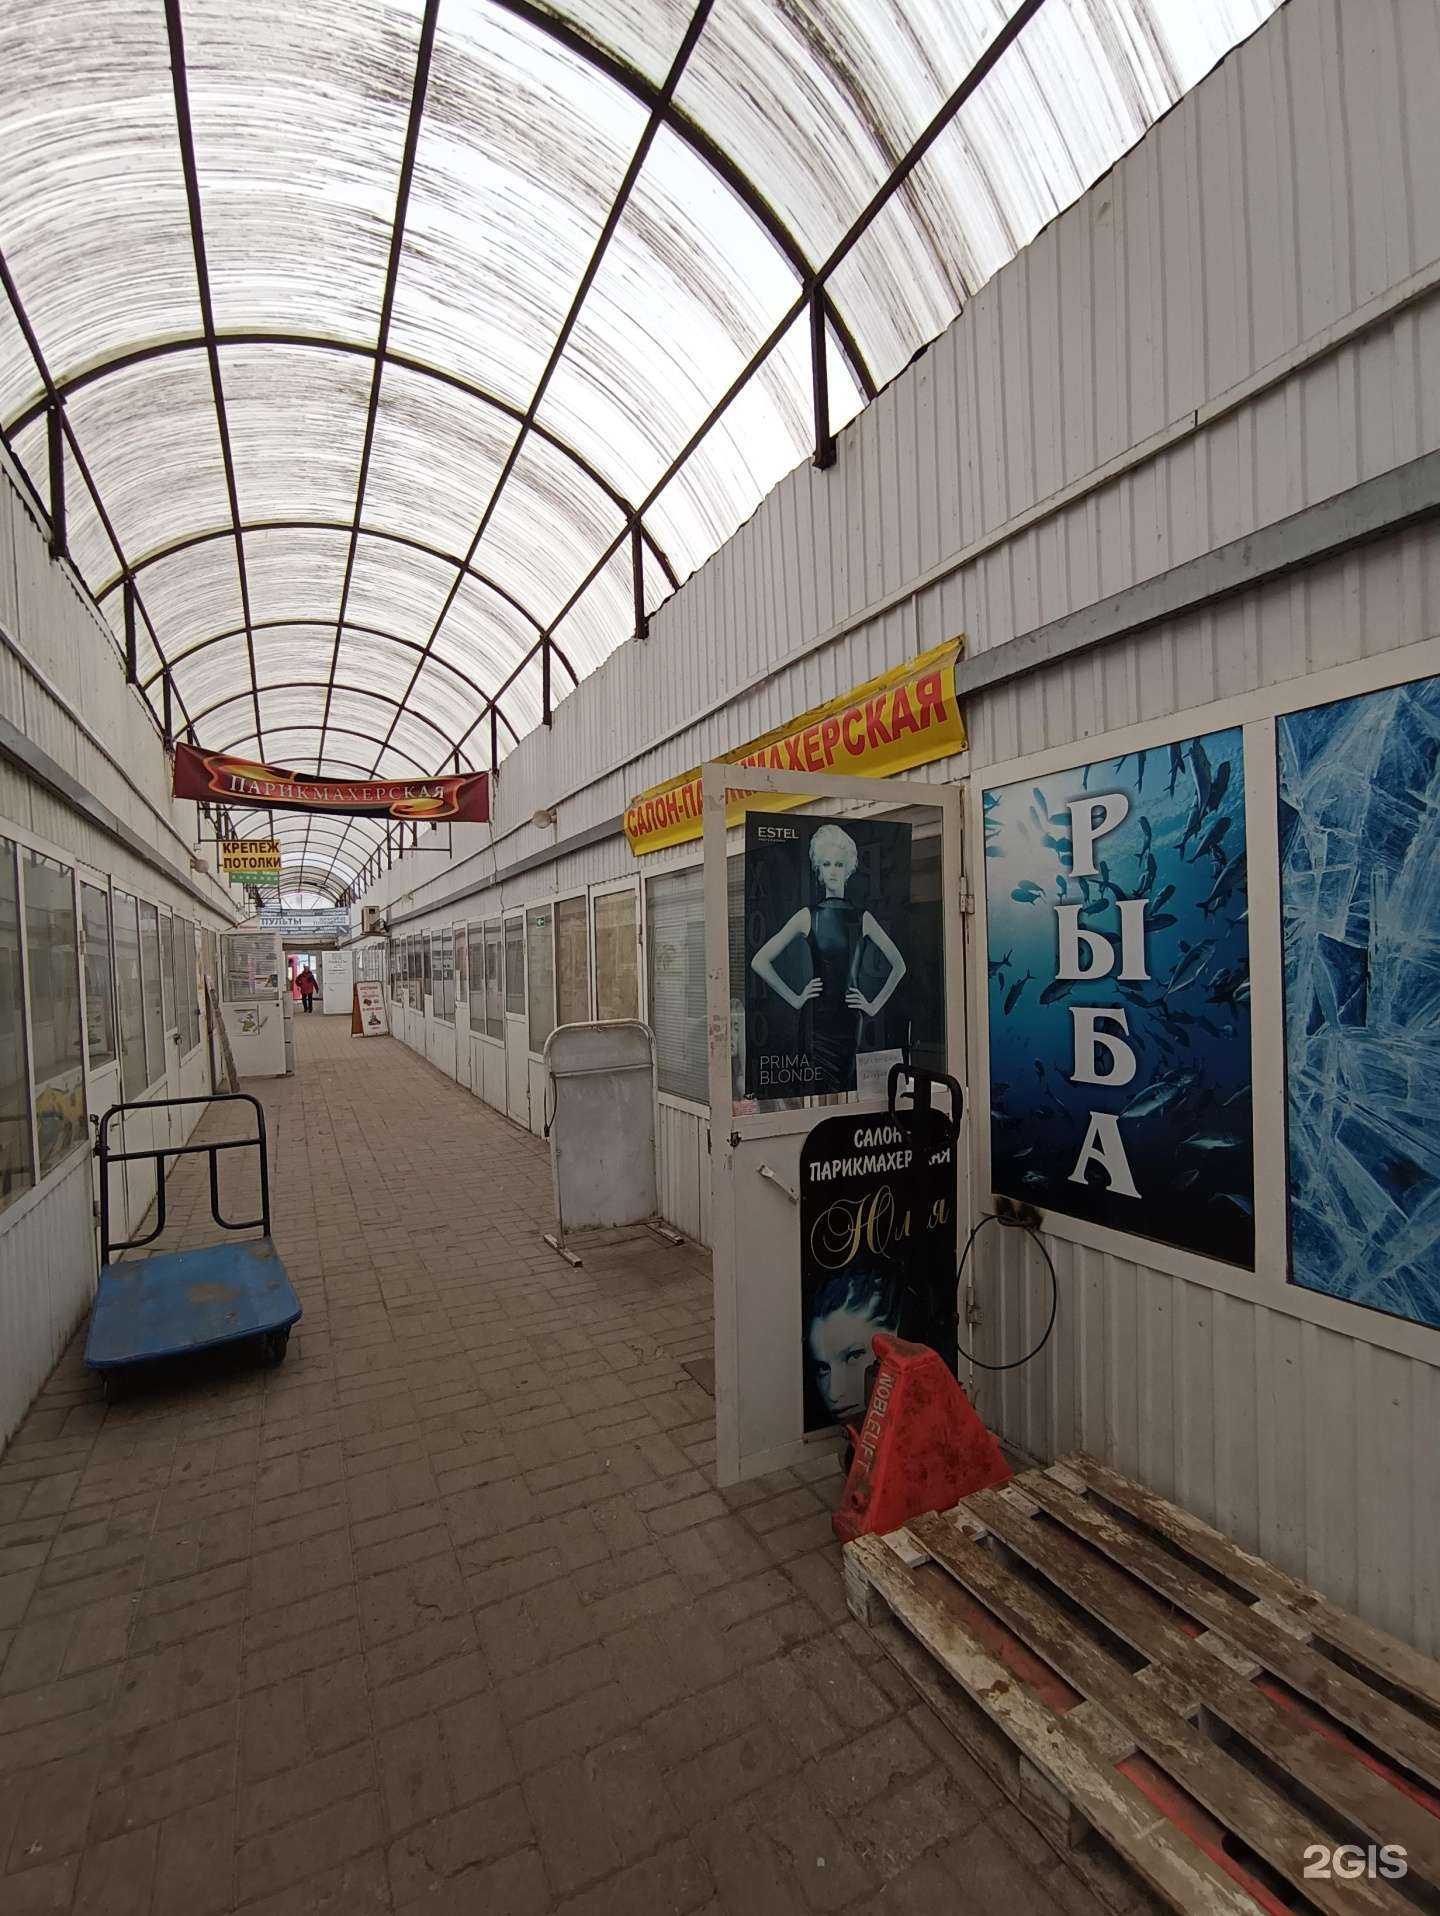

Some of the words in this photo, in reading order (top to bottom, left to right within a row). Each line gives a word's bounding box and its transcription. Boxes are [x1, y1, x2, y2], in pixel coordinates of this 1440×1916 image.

[229, 775, 445, 800] ПАРИКМАХЕРСКАЯ
[757, 826, 800, 839] ESTEL
[222, 842, 280, 854] КРЕПЕЖ
[223, 857, 281, 869] ПОТОЛКИ
[261, 917, 302, 926] ПУЛЬТЫ
[1053, 793, 1151, 1199] РЫБА
[759, 1055, 810, 1070] PRIMA
[759, 1066, 824, 1085] BLONDE
[857, 1371, 894, 1473] NOBLELIFT
